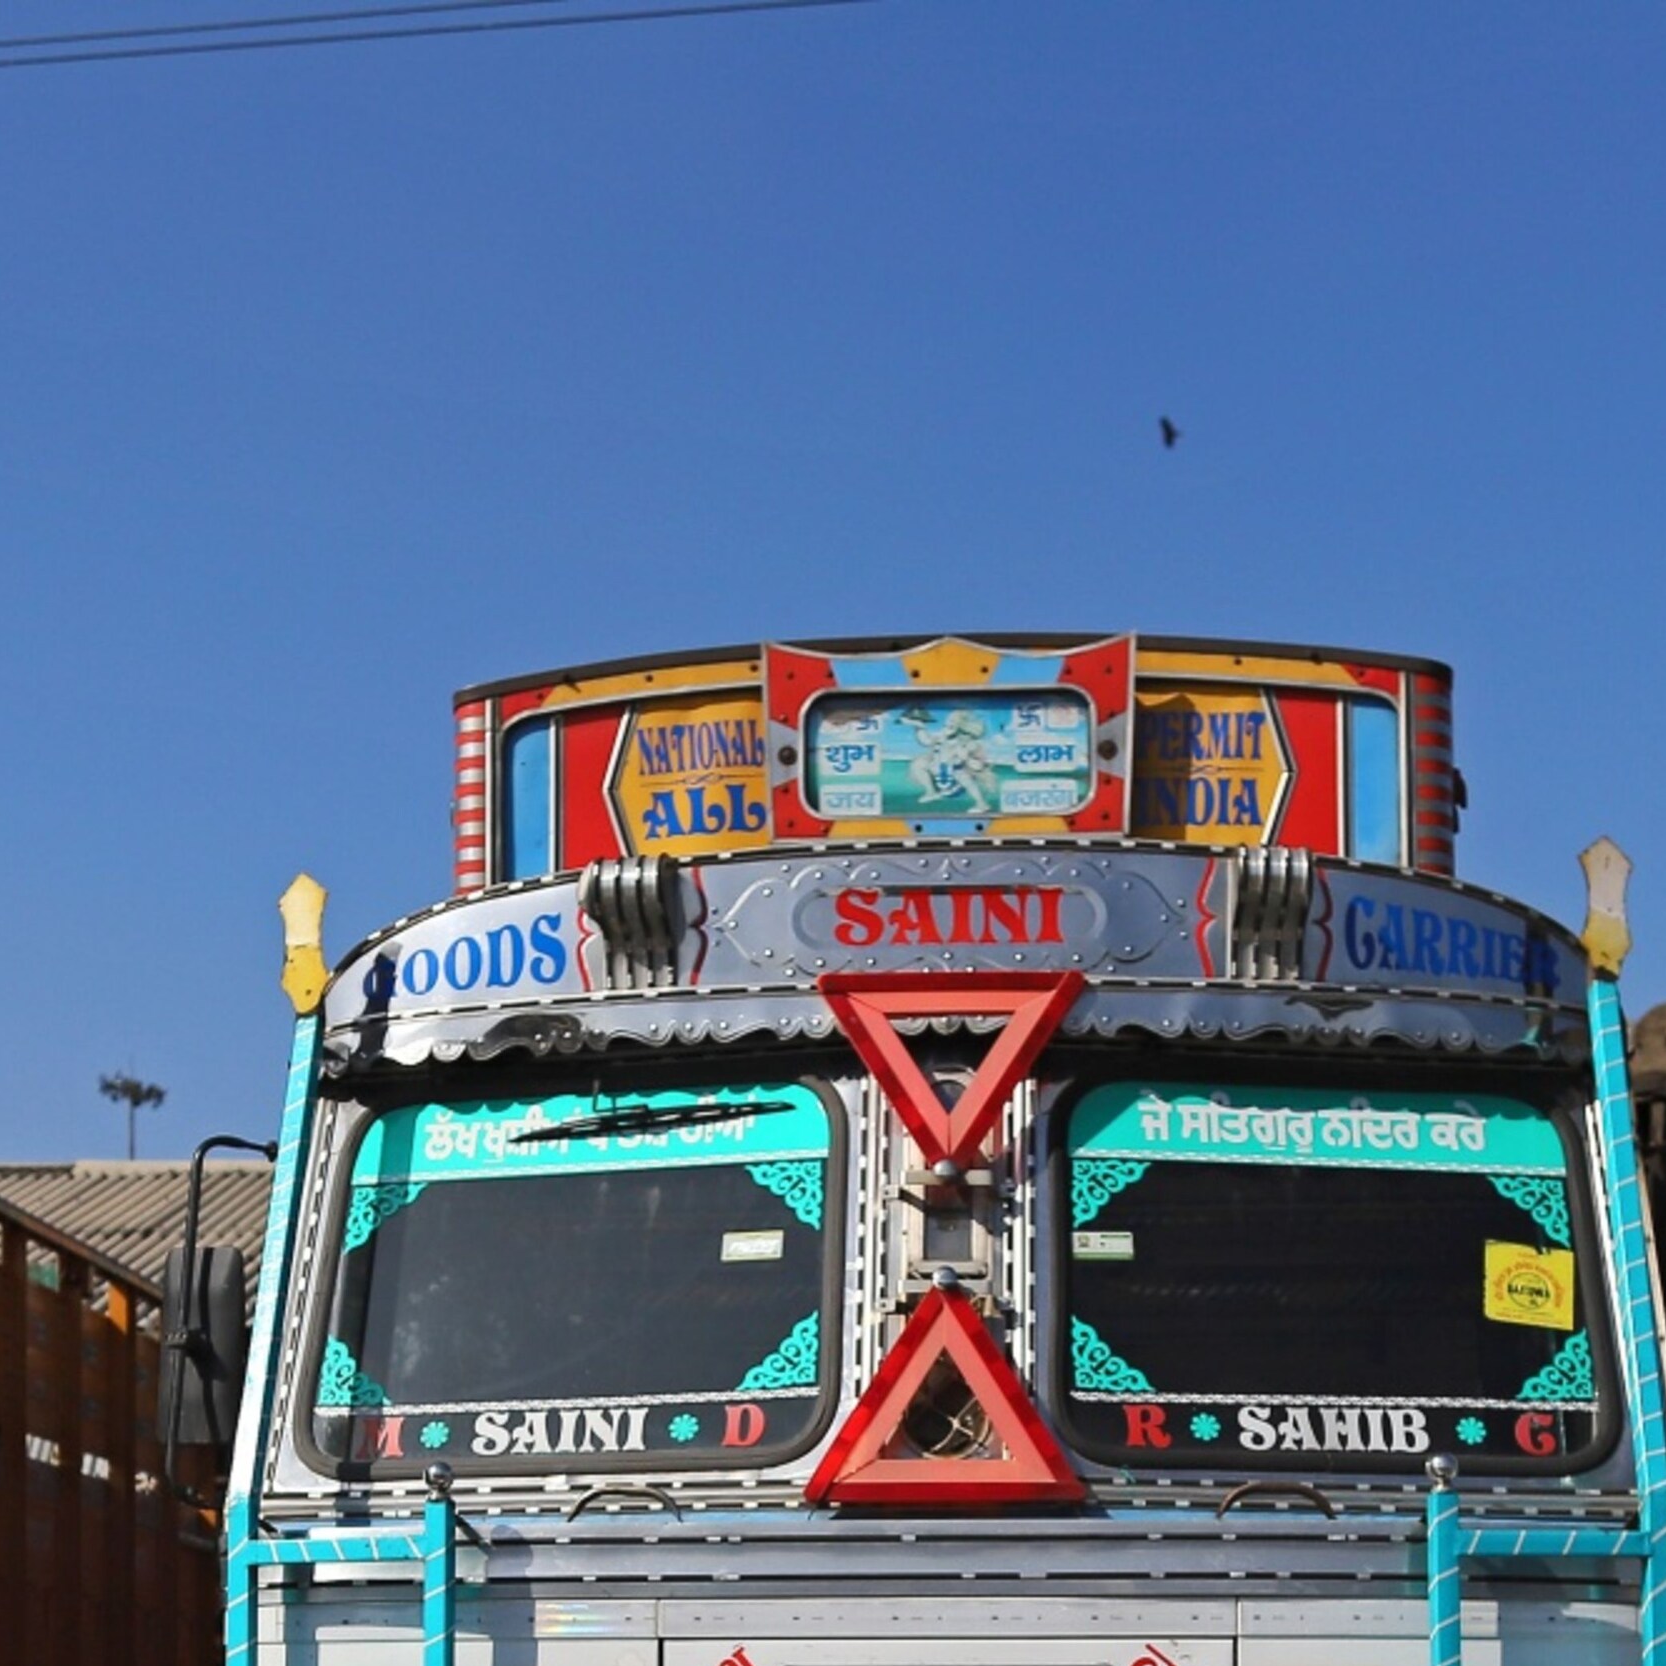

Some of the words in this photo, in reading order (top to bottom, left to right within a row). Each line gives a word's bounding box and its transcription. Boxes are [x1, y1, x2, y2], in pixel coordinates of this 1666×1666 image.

[636, 719, 767, 776] NATIONAL
[825, 743, 876, 774] शुभ
[1016, 743, 1076, 765] लाभ
[1136, 711, 1266, 760] PERMIT
[642, 783, 767, 841] ALL
[1136, 778, 1263, 827] INDIA
[833, 887, 1069, 948] SAINI
[1343, 894, 1562, 989] CARRIER
[362, 911, 568, 999] GOODS
[355, 1417, 404, 1458] M
[471, 1406, 650, 1457] SAINI
[721, 1403, 766, 1448] D
[1121, 1403, 1172, 1449] R
[1237, 1404, 1431, 1454] SAHIB
